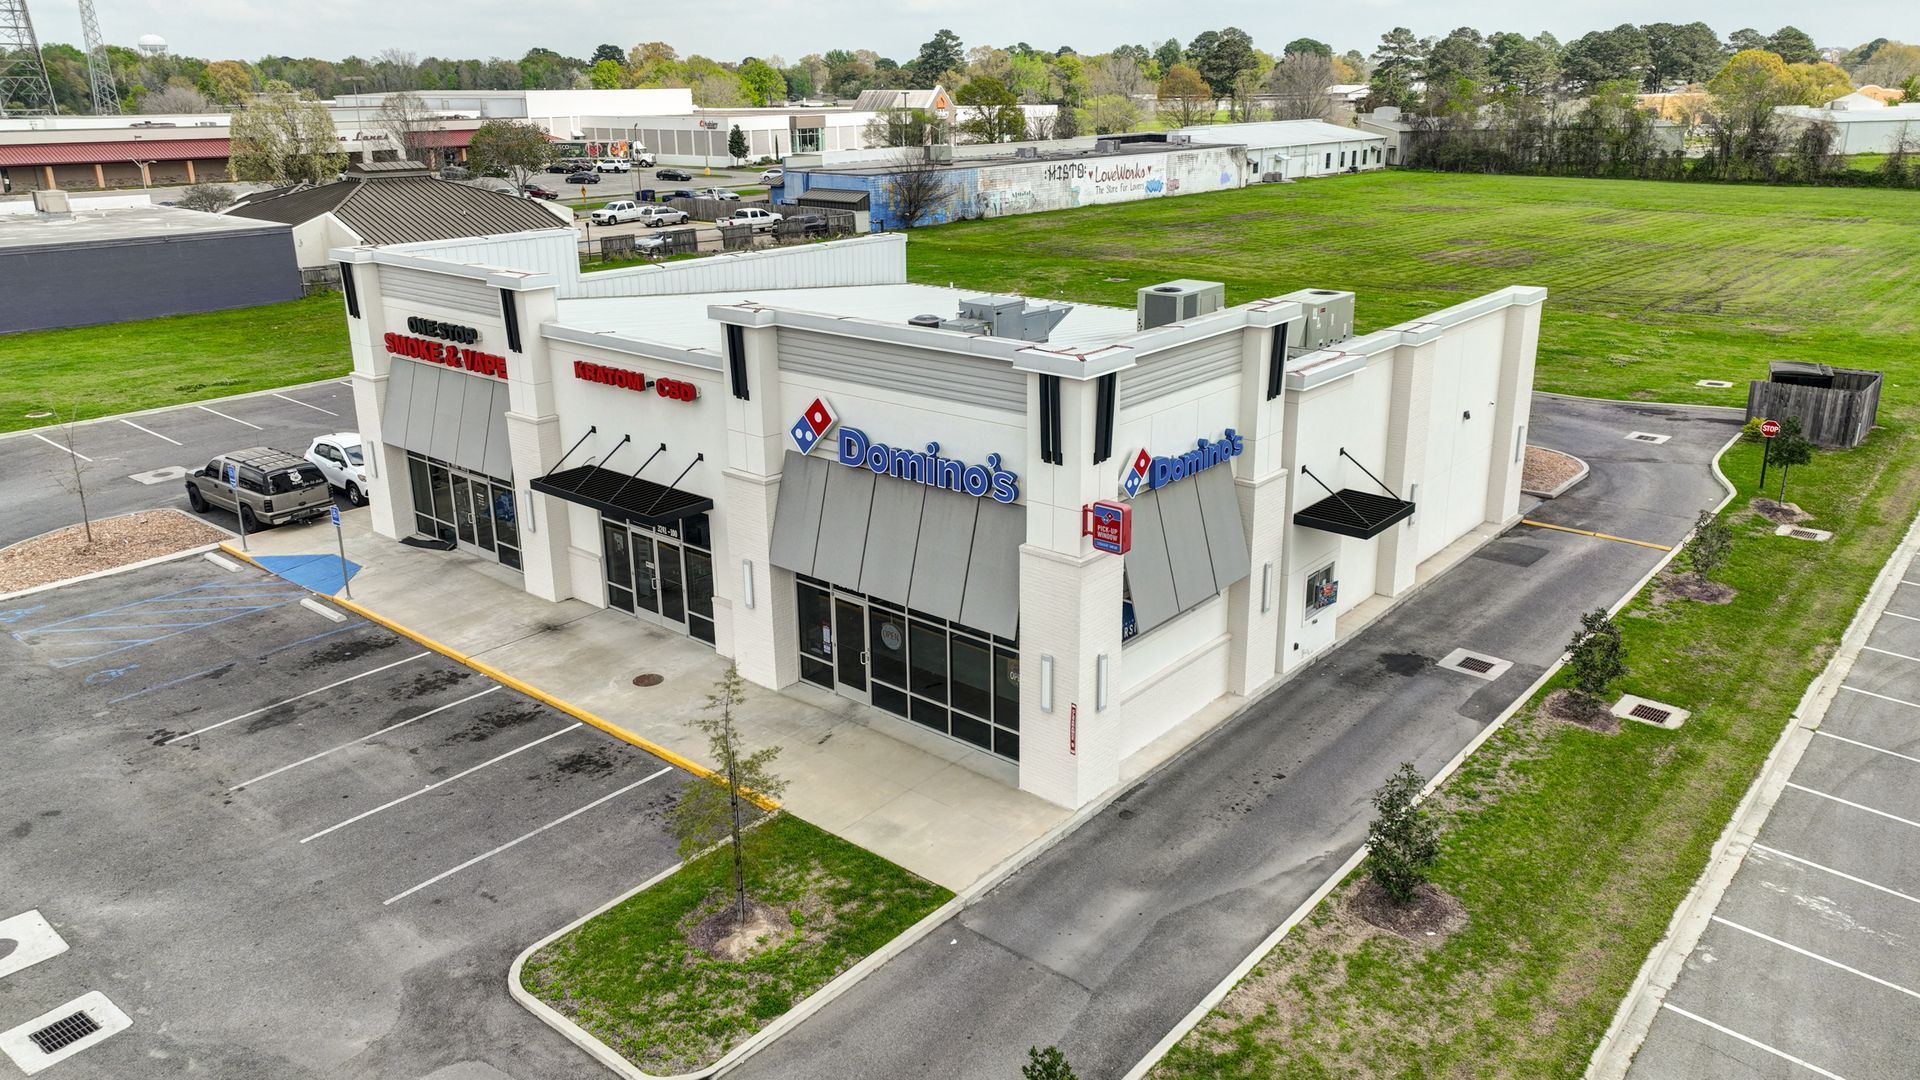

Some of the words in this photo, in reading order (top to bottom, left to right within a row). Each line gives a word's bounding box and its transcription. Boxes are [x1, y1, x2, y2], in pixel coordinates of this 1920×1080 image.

[407, 316, 438, 337] ONE
[438, 322, 478, 345] STOP
[384, 332, 445, 364] SMOKE
[446, 345, 463, 368] &
[461, 349, 508, 379] VAPE
[574, 361, 646, 392] KRATOM
[656, 377, 698, 402] CBD
[1762, 424, 1779, 432] STOP
[838, 426, 1019, 504] Domino's
[1149, 428, 1244, 490] Domino's
